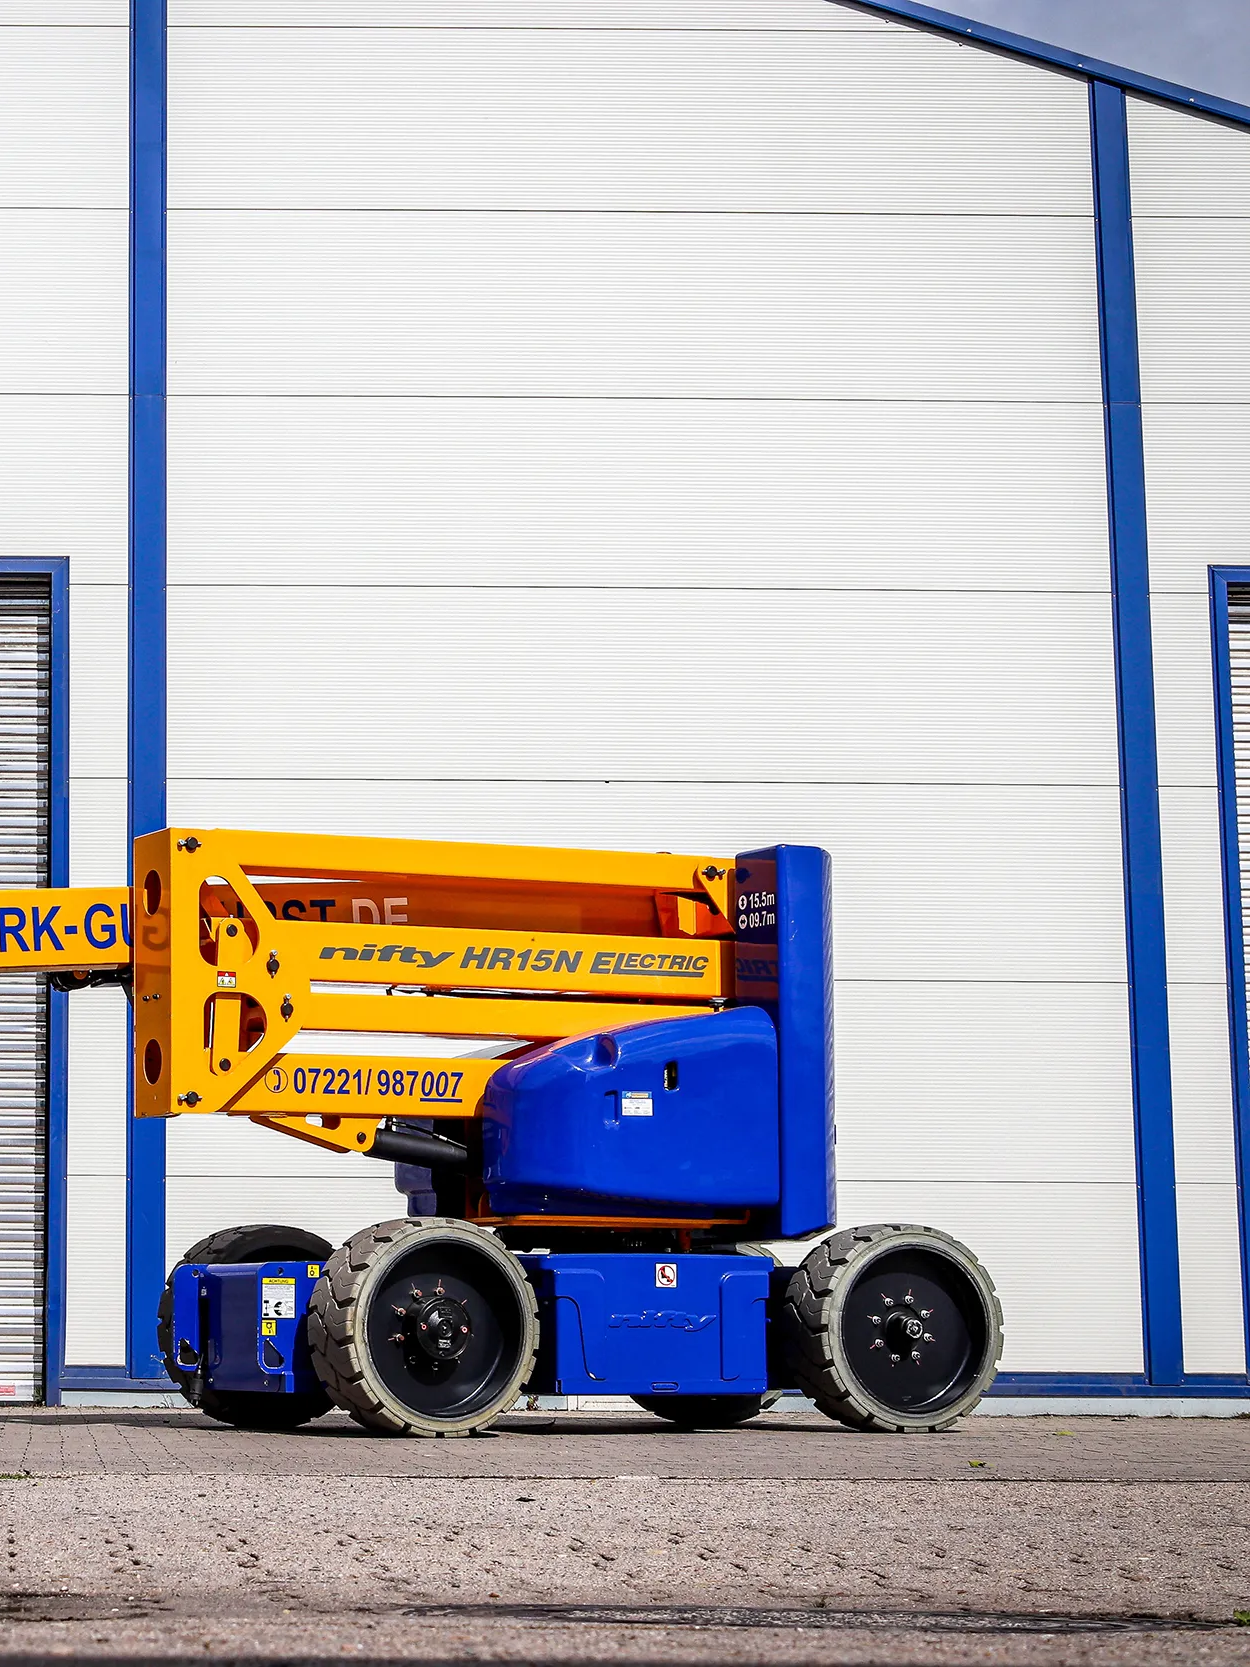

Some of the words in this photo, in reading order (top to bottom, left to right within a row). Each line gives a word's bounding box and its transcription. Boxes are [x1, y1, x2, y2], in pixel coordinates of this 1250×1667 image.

[749, 891, 776, 909] 15.5m
[749, 910, 776, 929] 09.7m
[319, 943, 456, 968] nifty
[460, 946, 583, 973] HR15N
[589, 952, 710, 978] ELECTRIC
[608, 1309, 717, 1333] nifty
